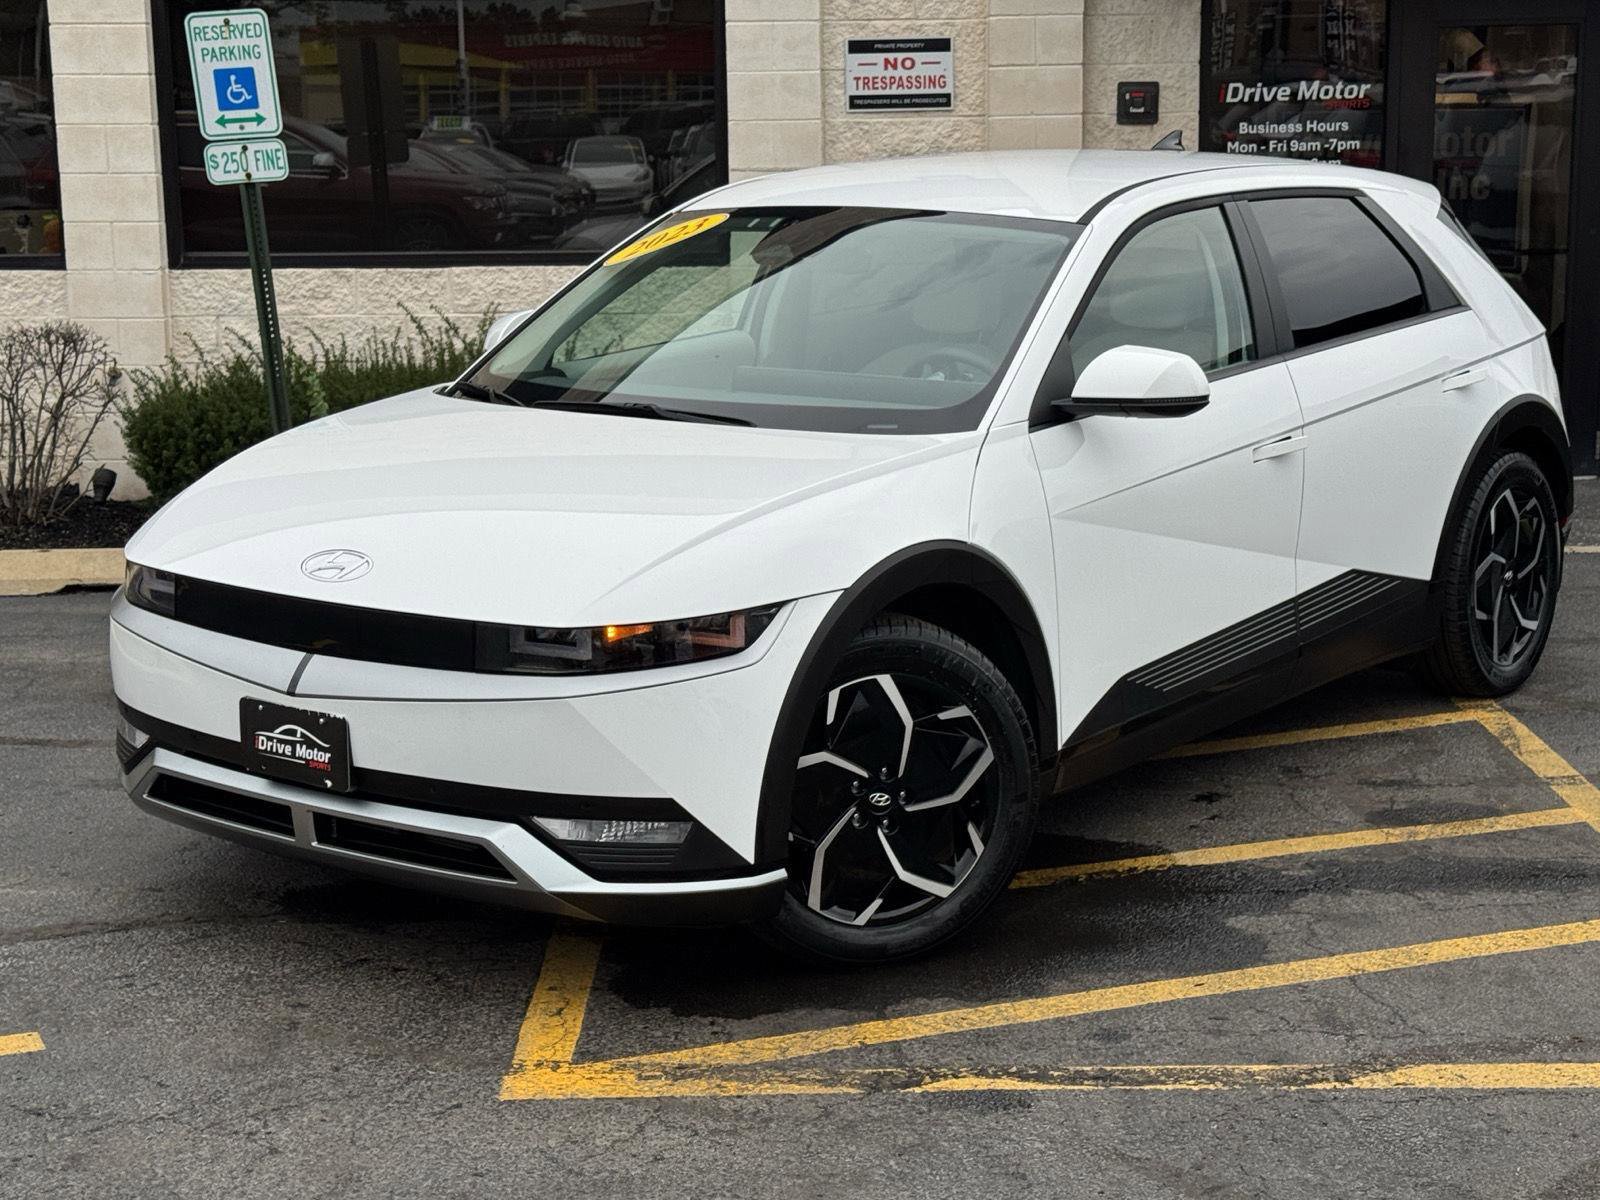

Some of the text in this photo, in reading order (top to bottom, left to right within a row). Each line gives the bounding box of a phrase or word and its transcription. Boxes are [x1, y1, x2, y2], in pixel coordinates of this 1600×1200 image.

[193, 22, 263, 42] RESERVED
[201, 44, 262, 63] PARKING
[883, 57, 916, 71] NO
[853, 75, 947, 91] TRESPASSING
[1218, 80, 1372, 103] iDrive Motor
[1239, 120, 1349, 134] Business Hours
[1227, 141, 1257, 153] Mon
[1269, 140, 1287, 152] Fri
[1290, 140, 1321, 151] 9am
[254, 148, 284, 172] FINE
[255, 736, 332, 763] iDrive Motor
